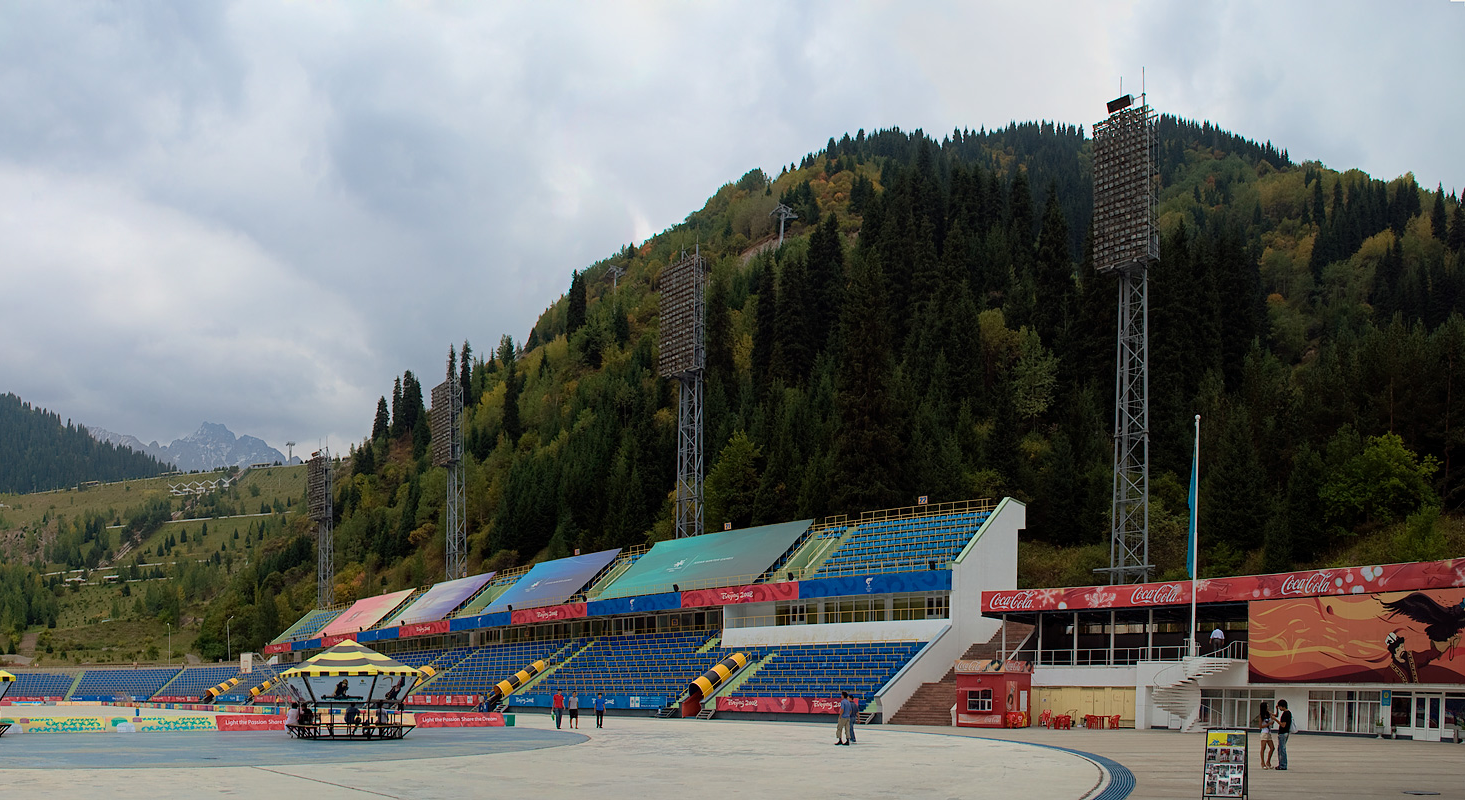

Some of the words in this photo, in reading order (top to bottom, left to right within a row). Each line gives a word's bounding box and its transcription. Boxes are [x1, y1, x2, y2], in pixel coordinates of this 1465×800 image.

[1281, 572, 1332, 595] Coca-Cola
[721, 592, 739, 600] Beijing
[1131, 584, 1179, 604] Coca-Cola
[990, 592, 1034, 610] Coca-Cola
[727, 699, 745, 707] Beijing
[812, 700, 832, 709] Beijing
